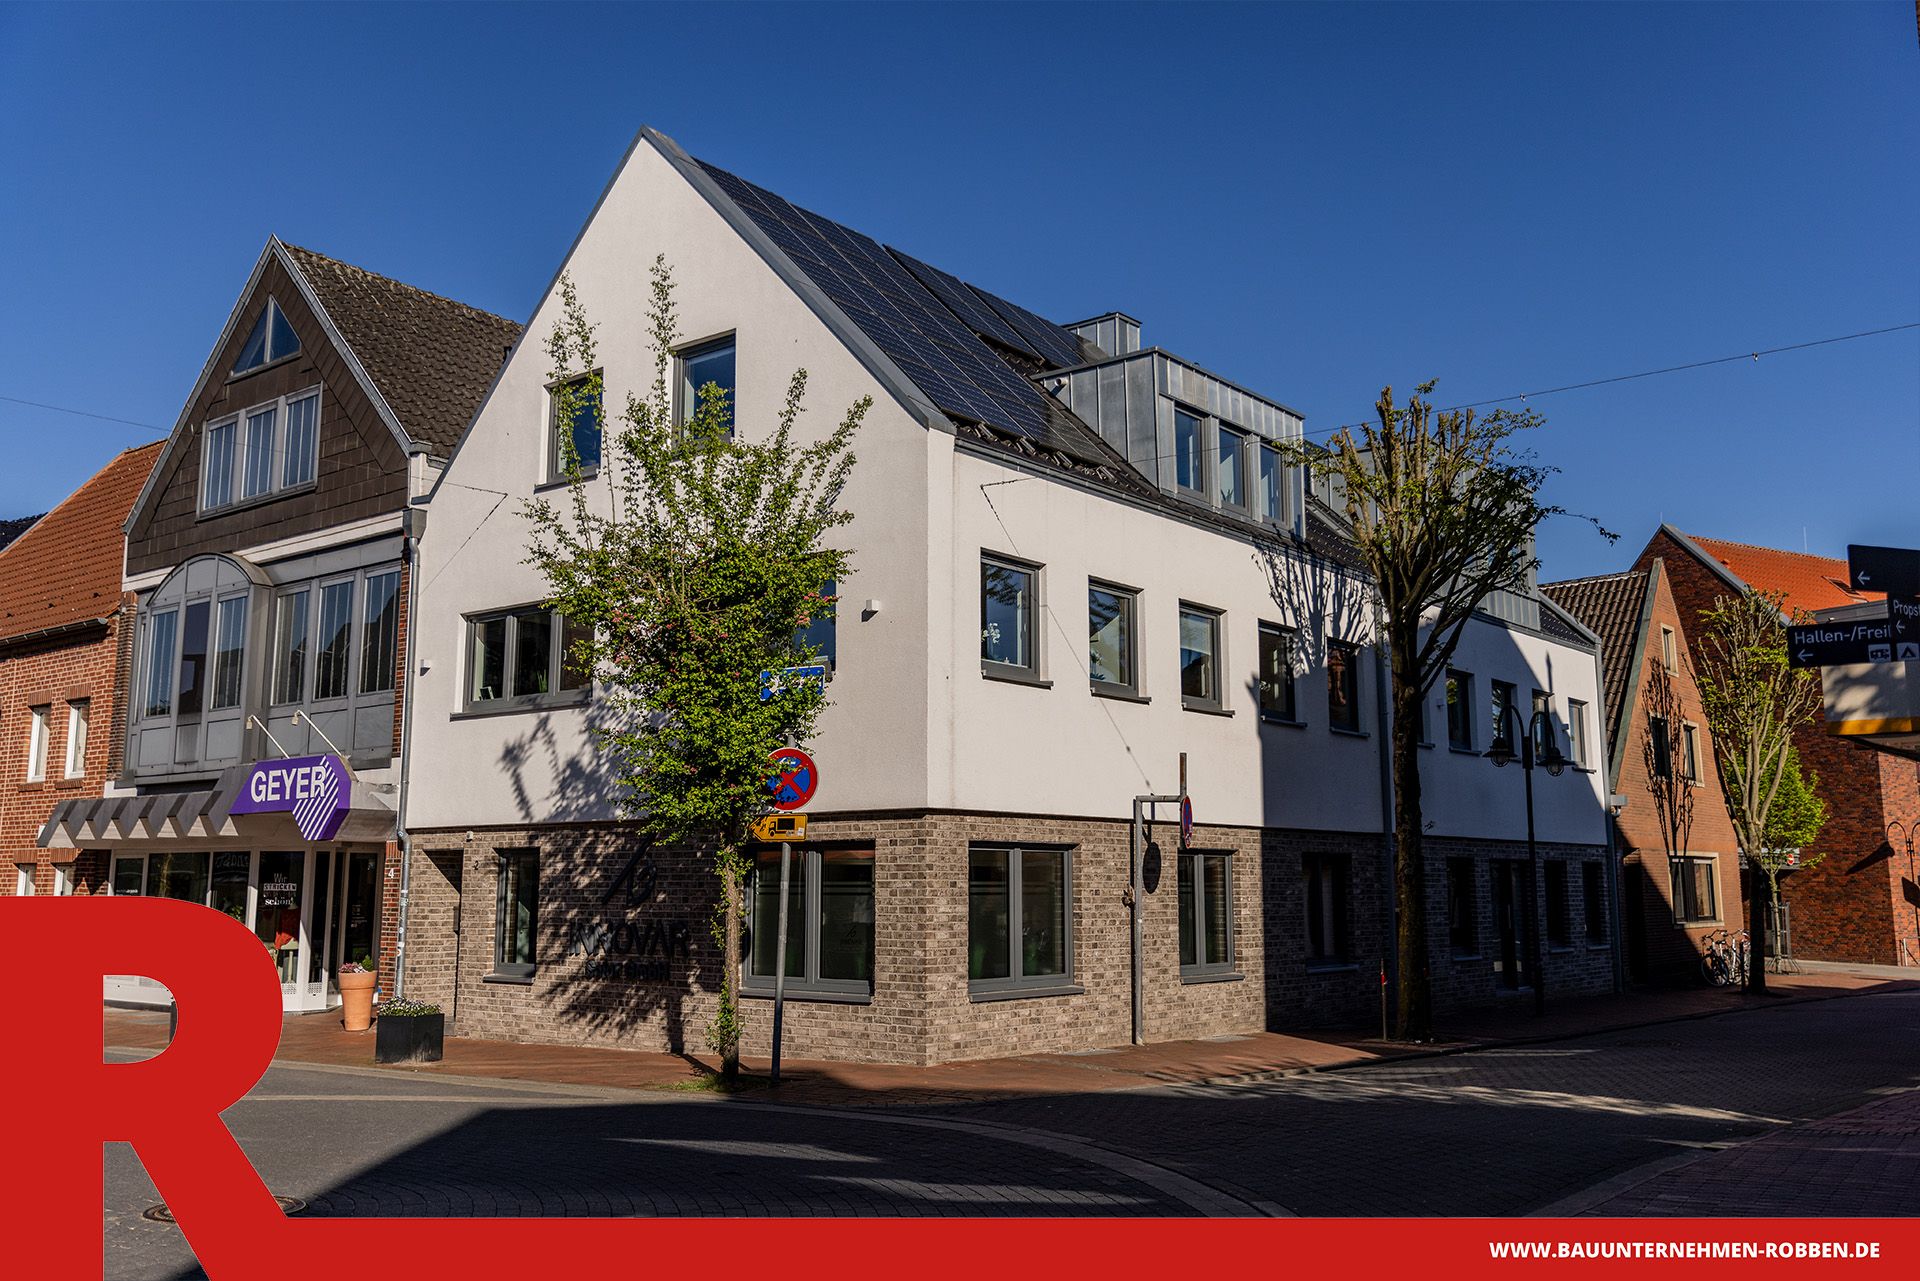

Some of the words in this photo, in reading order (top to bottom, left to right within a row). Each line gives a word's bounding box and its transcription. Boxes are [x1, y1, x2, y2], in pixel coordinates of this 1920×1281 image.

[250, 764, 327, 804] GEYER
[273, 872, 289, 883] Wir
[387, 867, 395, 879] 4
